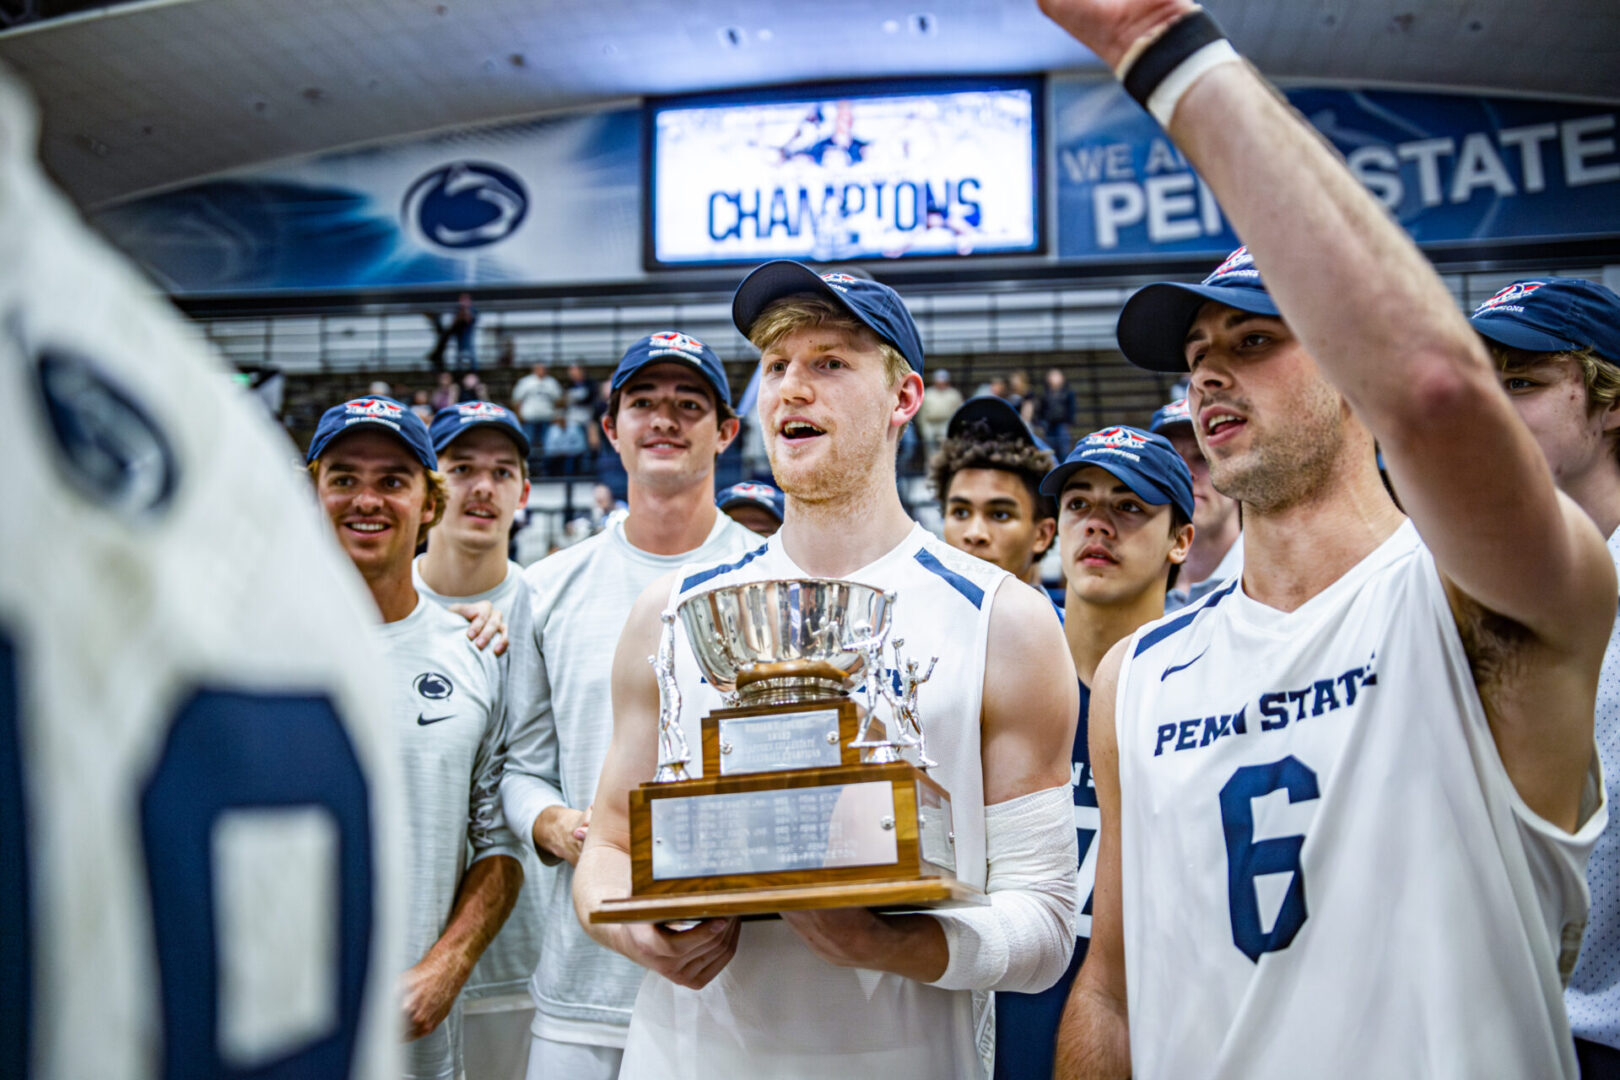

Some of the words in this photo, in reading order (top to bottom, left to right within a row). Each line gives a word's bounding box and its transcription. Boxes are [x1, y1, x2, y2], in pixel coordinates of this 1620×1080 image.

[1062, 143, 1134, 182] WE
[1094, 172, 1221, 248] PE
[1346, 114, 1620, 210] STATE
[1219, 754, 1321, 965] 6
